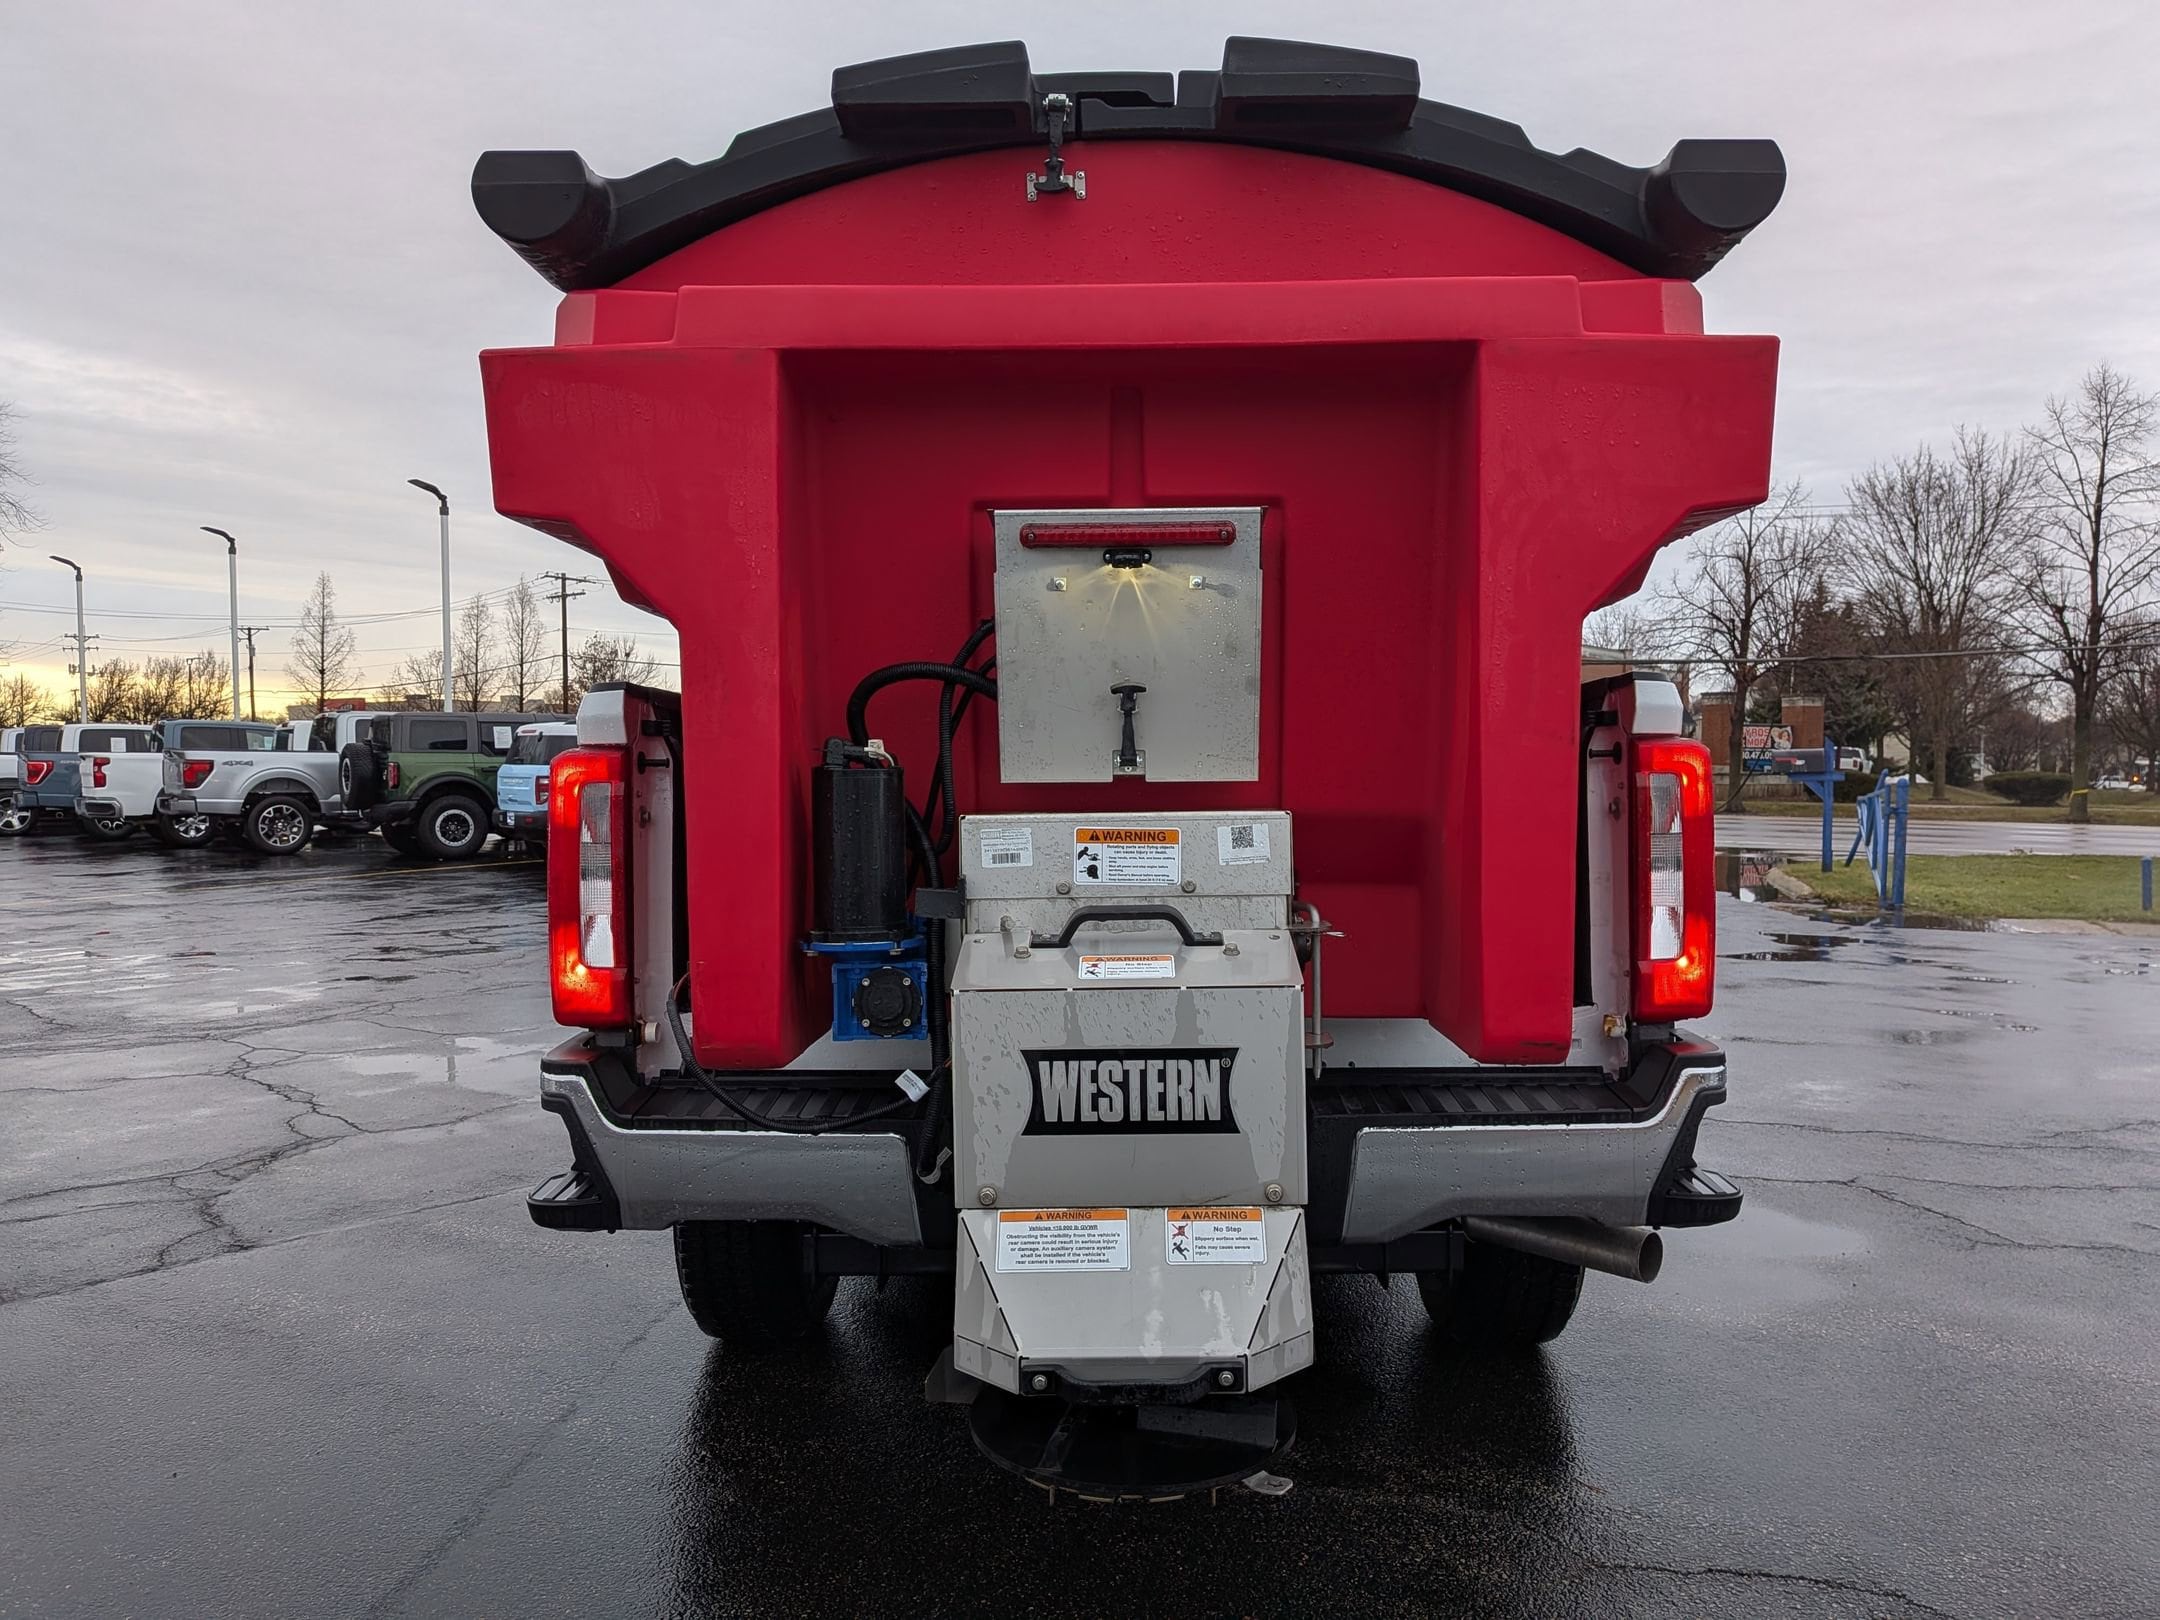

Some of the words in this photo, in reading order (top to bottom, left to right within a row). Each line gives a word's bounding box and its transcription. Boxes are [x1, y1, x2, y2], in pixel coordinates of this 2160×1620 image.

[1744, 728, 1769, 737] YROS
[1102, 831, 1166, 841] WARNING
[1046, 1211, 1092, 1220] WARNING
[1193, 1211, 1247, 1219] WARNING
